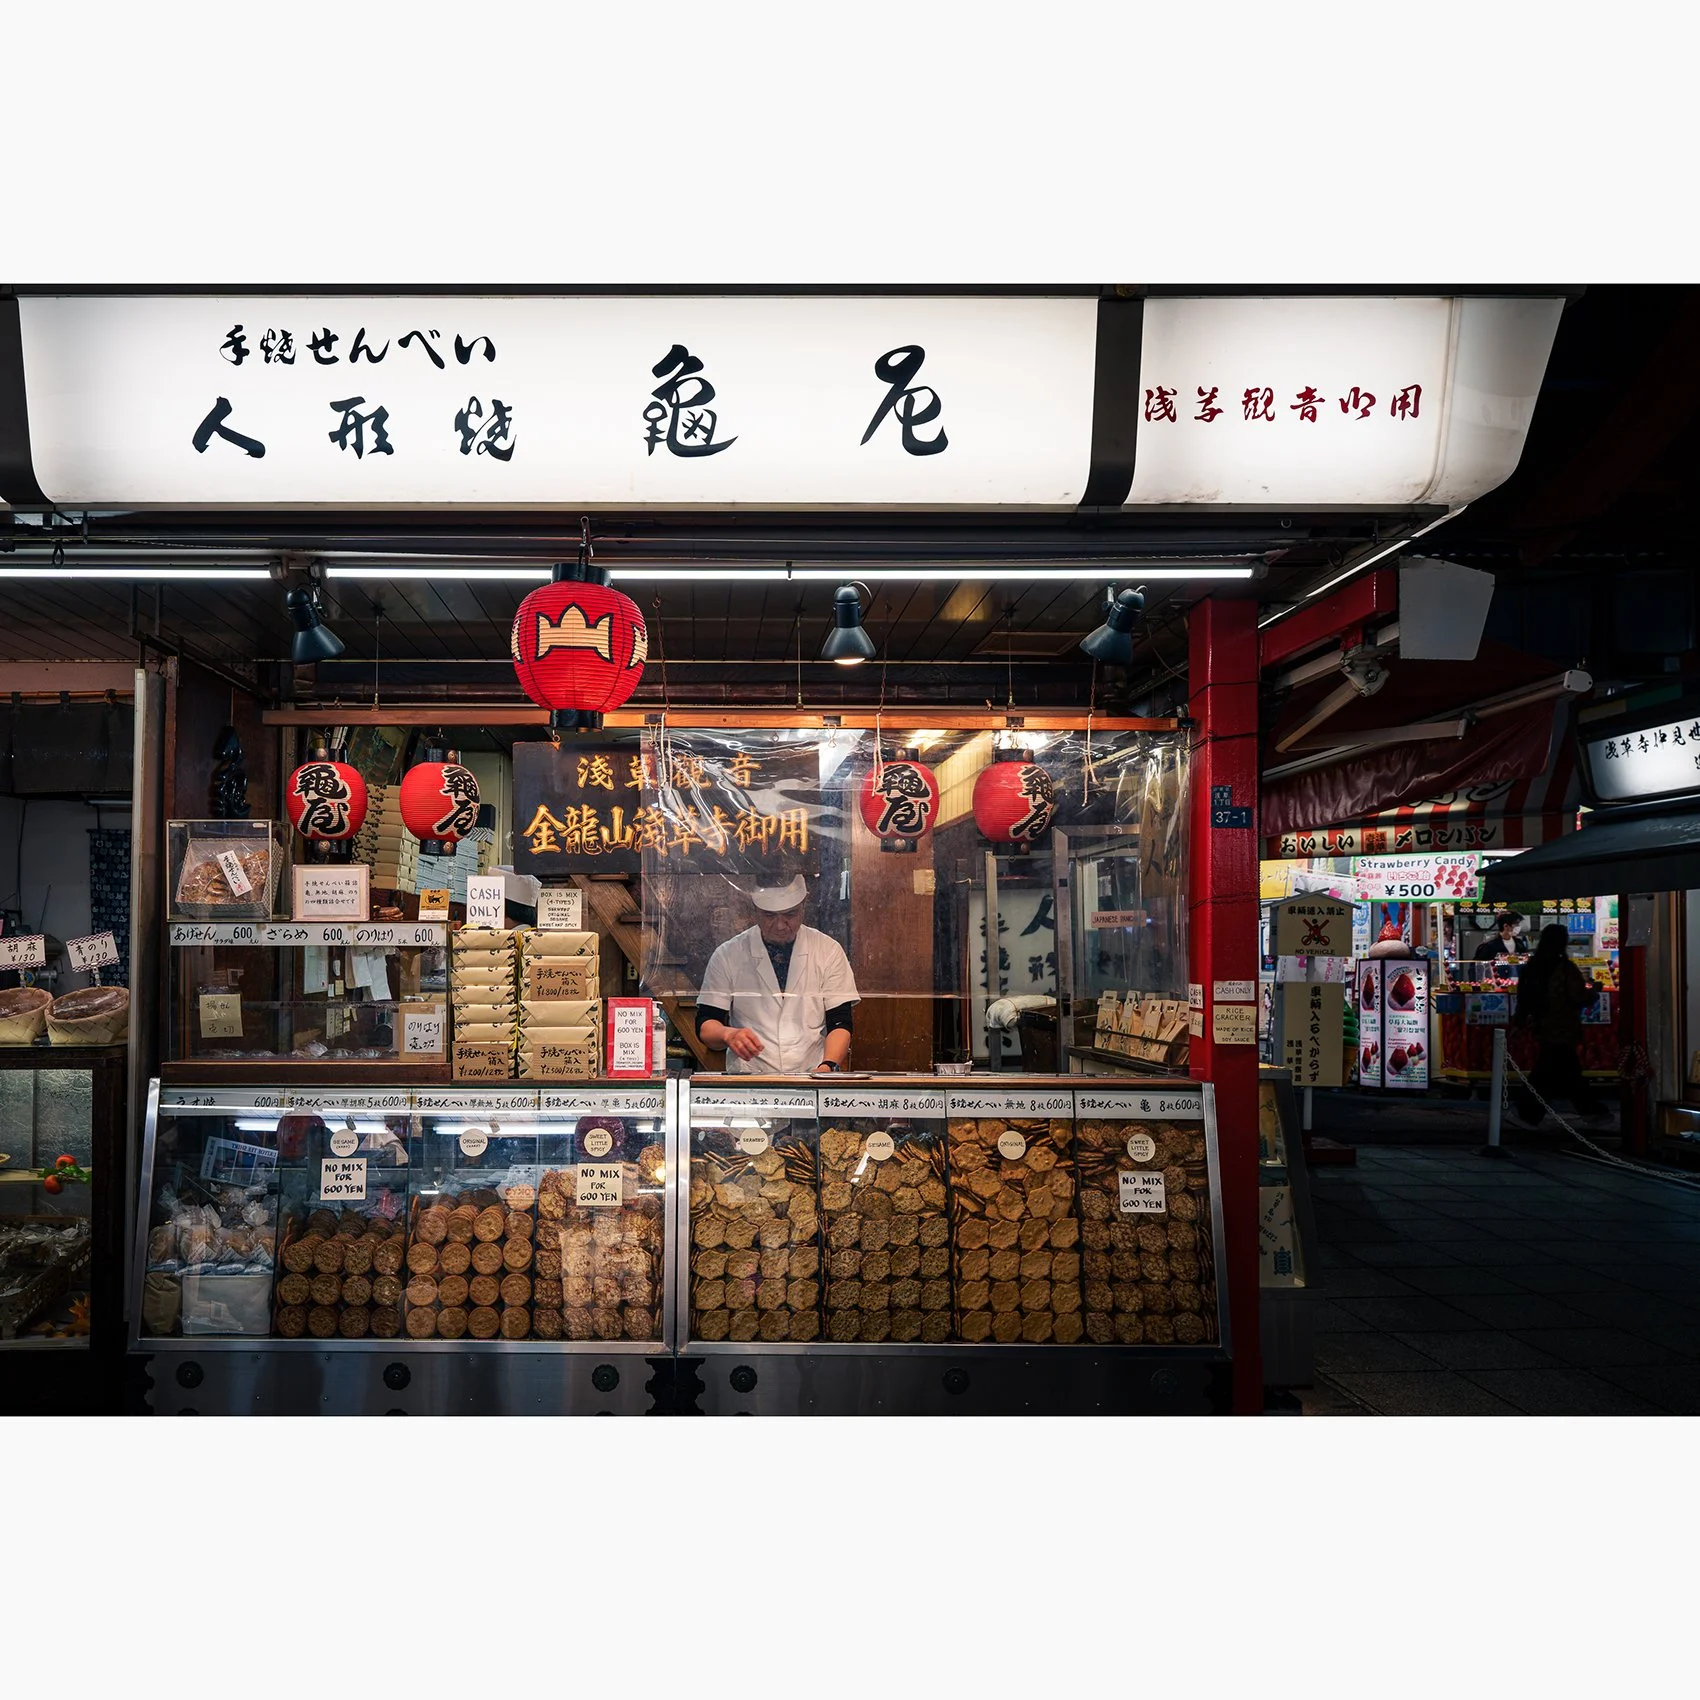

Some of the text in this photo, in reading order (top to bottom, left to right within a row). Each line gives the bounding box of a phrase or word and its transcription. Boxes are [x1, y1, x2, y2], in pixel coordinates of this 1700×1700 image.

[219, 324, 497, 369] 手焼せんべい
[192, 395, 518, 462] 人形焼
[1215, 811, 1247, 824] 37-1
[1395, 826, 1497, 847] メロンパン
[1280, 834, 1355, 853] おいしい
[1360, 856, 1474, 869] Strawberry Candy
[470, 887, 501, 900] CASH
[1385, 884, 1435, 897] ¥500
[470, 905, 501, 918] ONLY
[174, 926, 217, 940] あげせん
[233, 926, 253, 939] 600
[266, 928, 308, 941] ざらめ
[323, 928, 343, 941] 600
[414, 928, 433, 943] 600
[7, 941, 38, 953] 胡麻
[75, 940, 109, 956] 青のり
[11, 953, 36, 962] ¥130
[81, 952, 108, 964] ¥130
[536, 968, 582, 979] 手焼せんべい
[1235, 986, 1252, 994] ONLY
[456, 1048, 505, 1060] 手焼せんべい
[540, 1047, 586, 1058] 手焼せんべい
[254, 1096, 279, 1108] 600円
[287, 1096, 340, 1108] 手焼せんべい
[416, 1096, 468, 1108] 手焼せんべい
[545, 1097, 597, 1108] 手焼せんべい
[823, 1097, 876, 1108] 手焼せんべい
[950, 1098, 1001, 1109] 手焼せんべい
[1080, 1098, 1132, 1110] 手焼せんべい
[324, 1163, 363, 1172] NO MIX
[581, 1169, 620, 1178] NO MIX
[335, 1173, 353, 1181] FOR
[1122, 1176, 1163, 1186] NO MIX
[324, 1184, 364, 1194] 600 YEN
[590, 1182, 606, 1190] FOR
[1134, 1186, 1152, 1195] FOR
[580, 1192, 618, 1201] 600 YEN
[1122, 1199, 1163, 1209] 600 YEN
